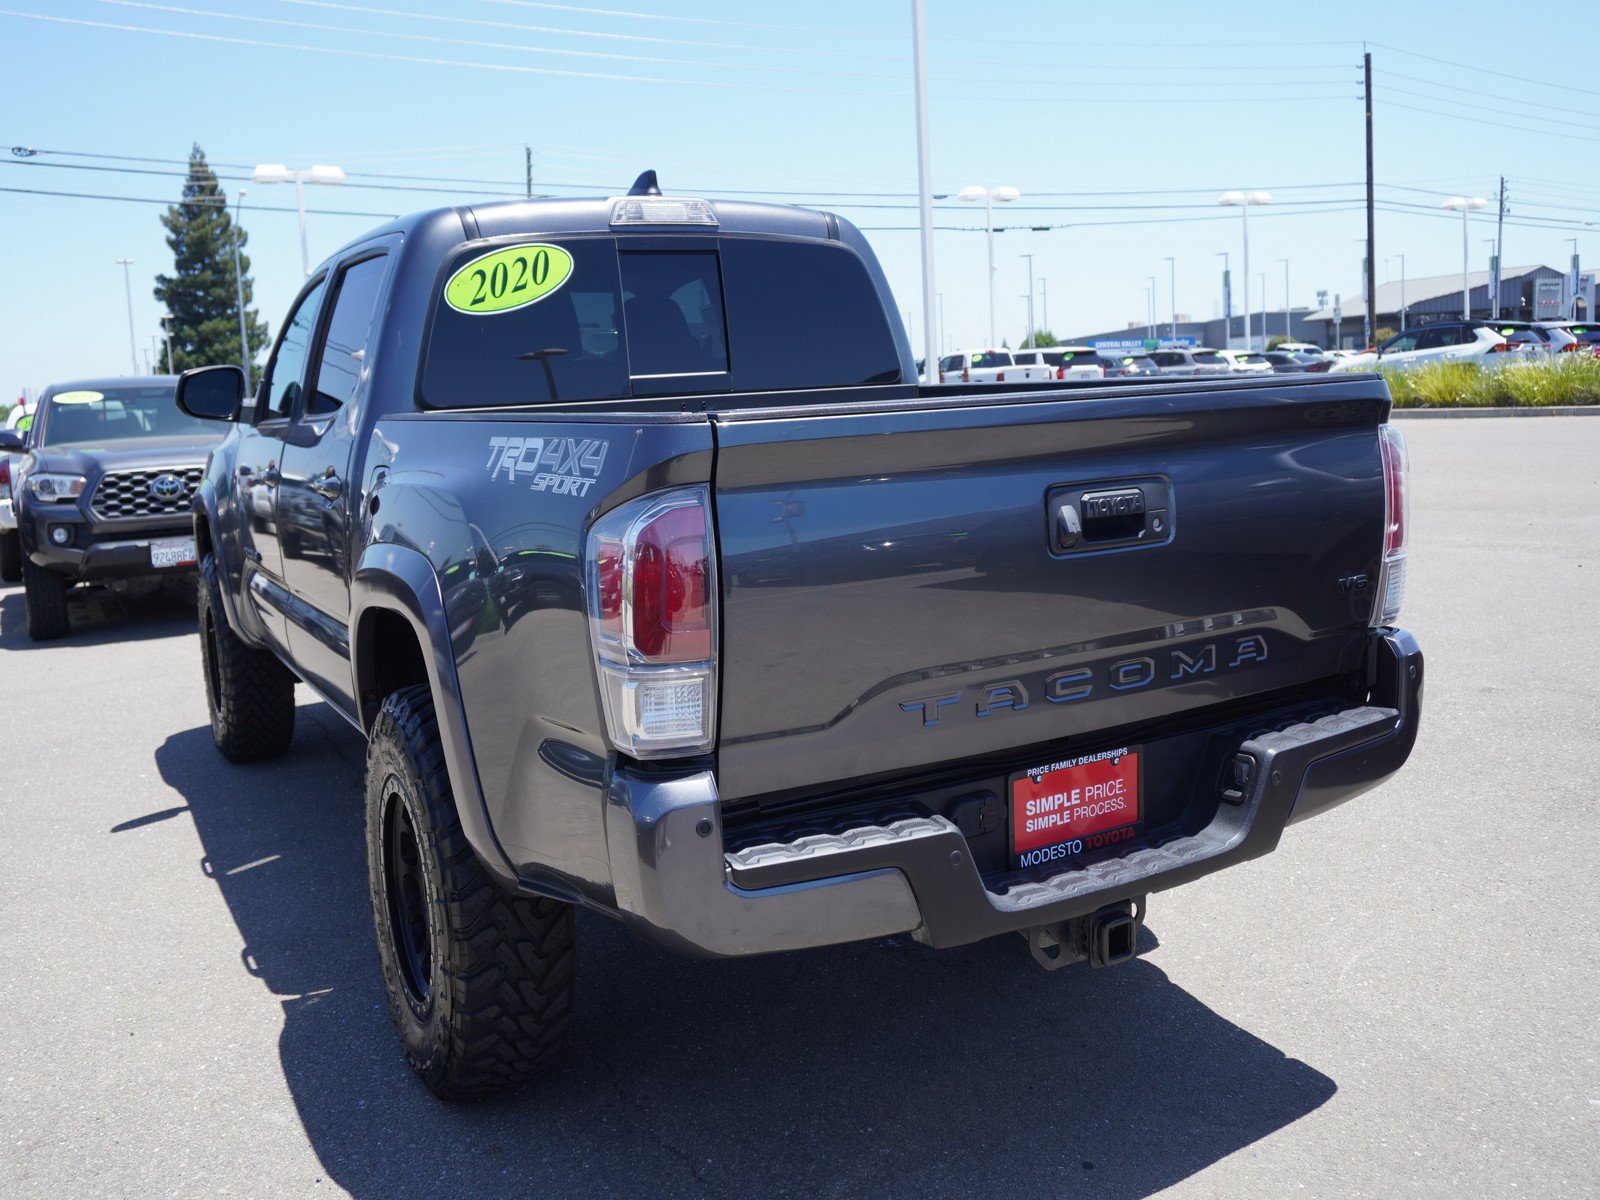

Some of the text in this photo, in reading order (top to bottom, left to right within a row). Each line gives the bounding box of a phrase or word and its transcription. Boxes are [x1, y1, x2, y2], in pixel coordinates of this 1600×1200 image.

[469, 249, 549, 306] 2020
[1121, 340, 1142, 348] VALLEY
[486, 436, 544, 484] TRD
[530, 472, 597, 497] SPORT
[1088, 496, 1140, 515] TOYOTA
[1338, 574, 1368, 593] V6
[899, 634, 1268, 727] TACOMA
[1027, 747, 1128, 777] PRICE FAMILY DEALERSHIPS
[1026, 778, 1127, 816] SIMPLE PRICE.
[1026, 797, 1127, 833] SIMPLE PROCESS.
[1020, 826, 1136, 868] MODESTO TOYOTA
